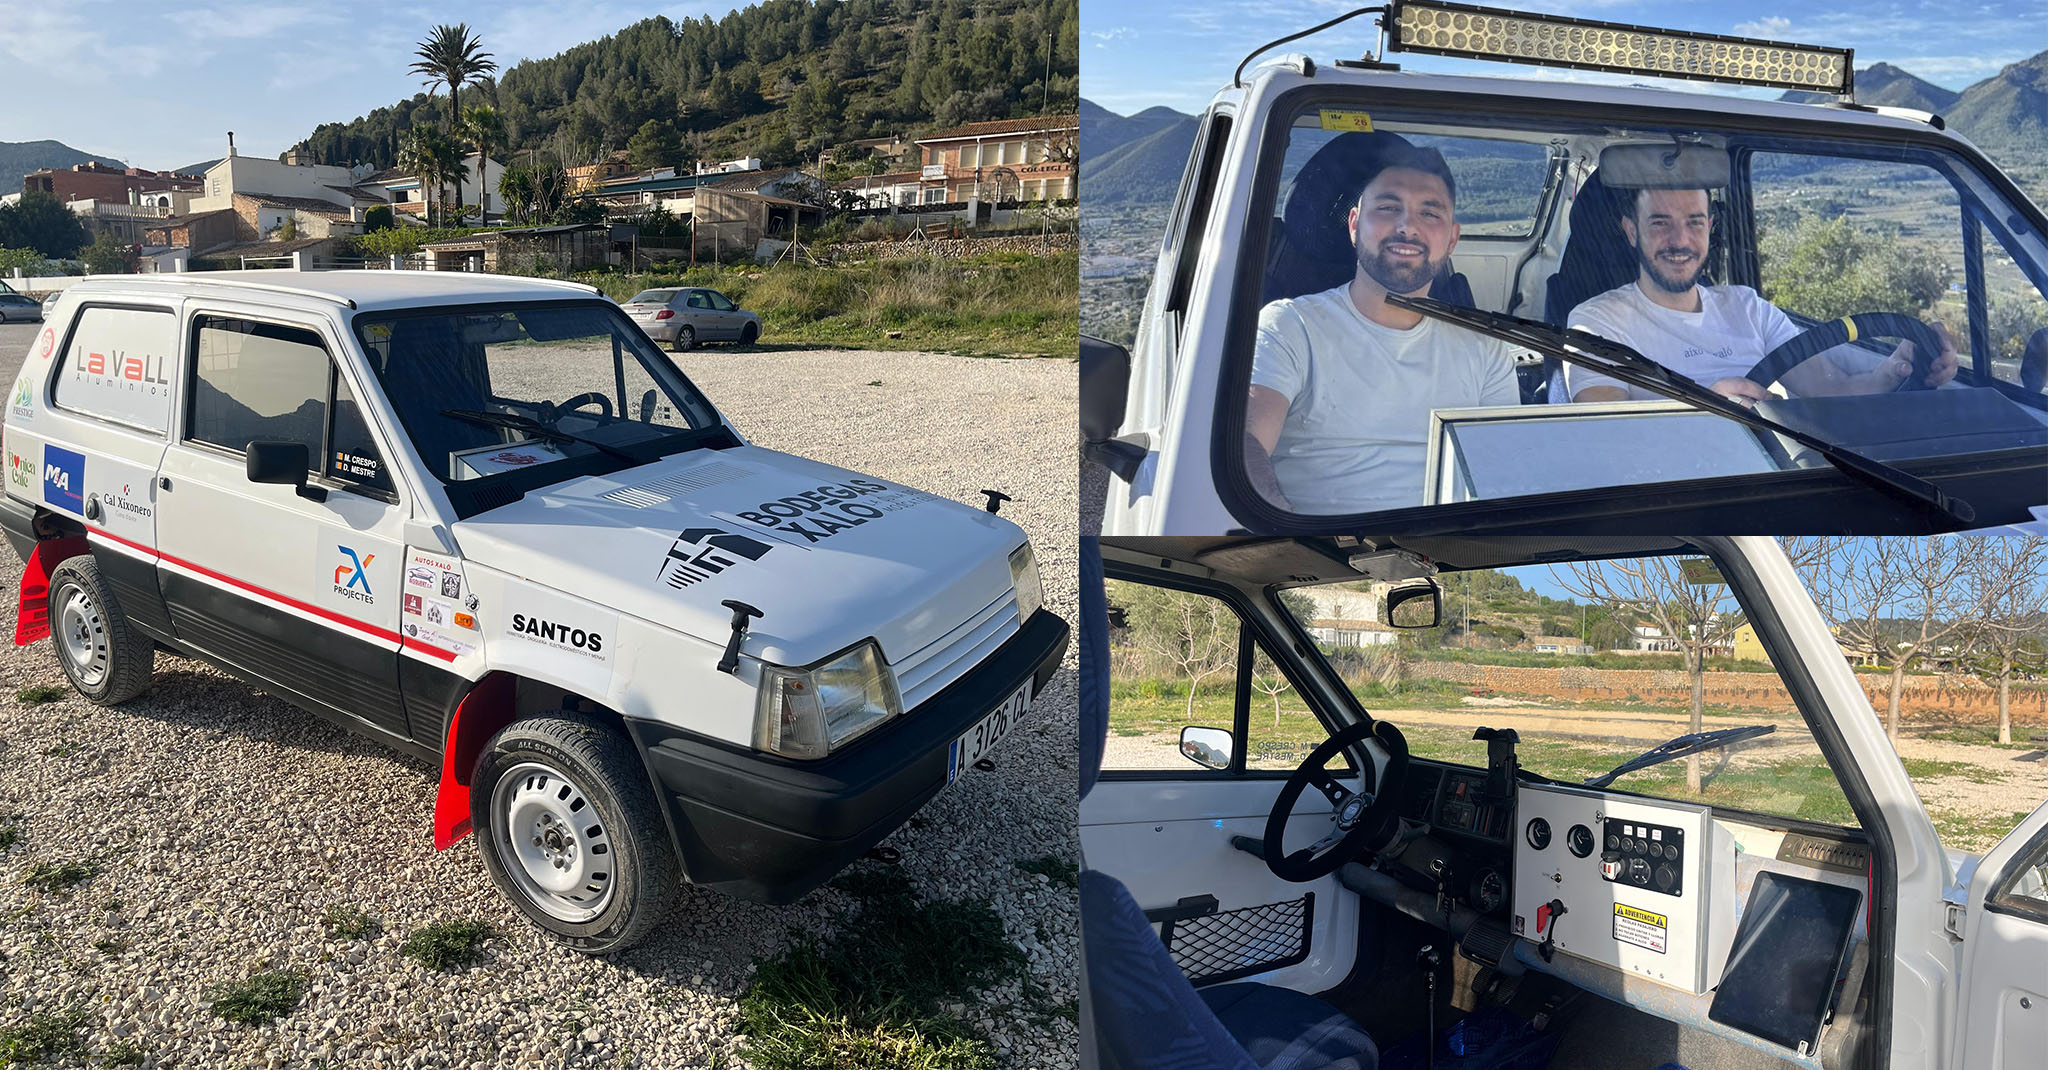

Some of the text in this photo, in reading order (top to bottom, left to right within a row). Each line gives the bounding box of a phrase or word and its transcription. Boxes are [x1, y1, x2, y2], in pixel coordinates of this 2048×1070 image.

[1354, 118, 1367, 126] 26
[75, 373, 168, 397] Aluminios
[13, 406, 34, 418] PRESTIGE
[344, 454, 377, 468] M. CRESPO
[351, 466, 376, 478] MESTRE
[104, 493, 115, 506] Cal
[118, 497, 152, 517] Xixonero
[735, 479, 888, 528] BODEGAS
[415, 556, 434, 566] AUTOS
[333, 585, 374, 605] PROJECTES
[512, 614, 602, 652] SANTOS
[957, 687, 1027, 776] A 3126 CL
[518, 741, 572, 766] ALL SEASON
[1625, 909, 1655, 923] ADVERTENCIA
